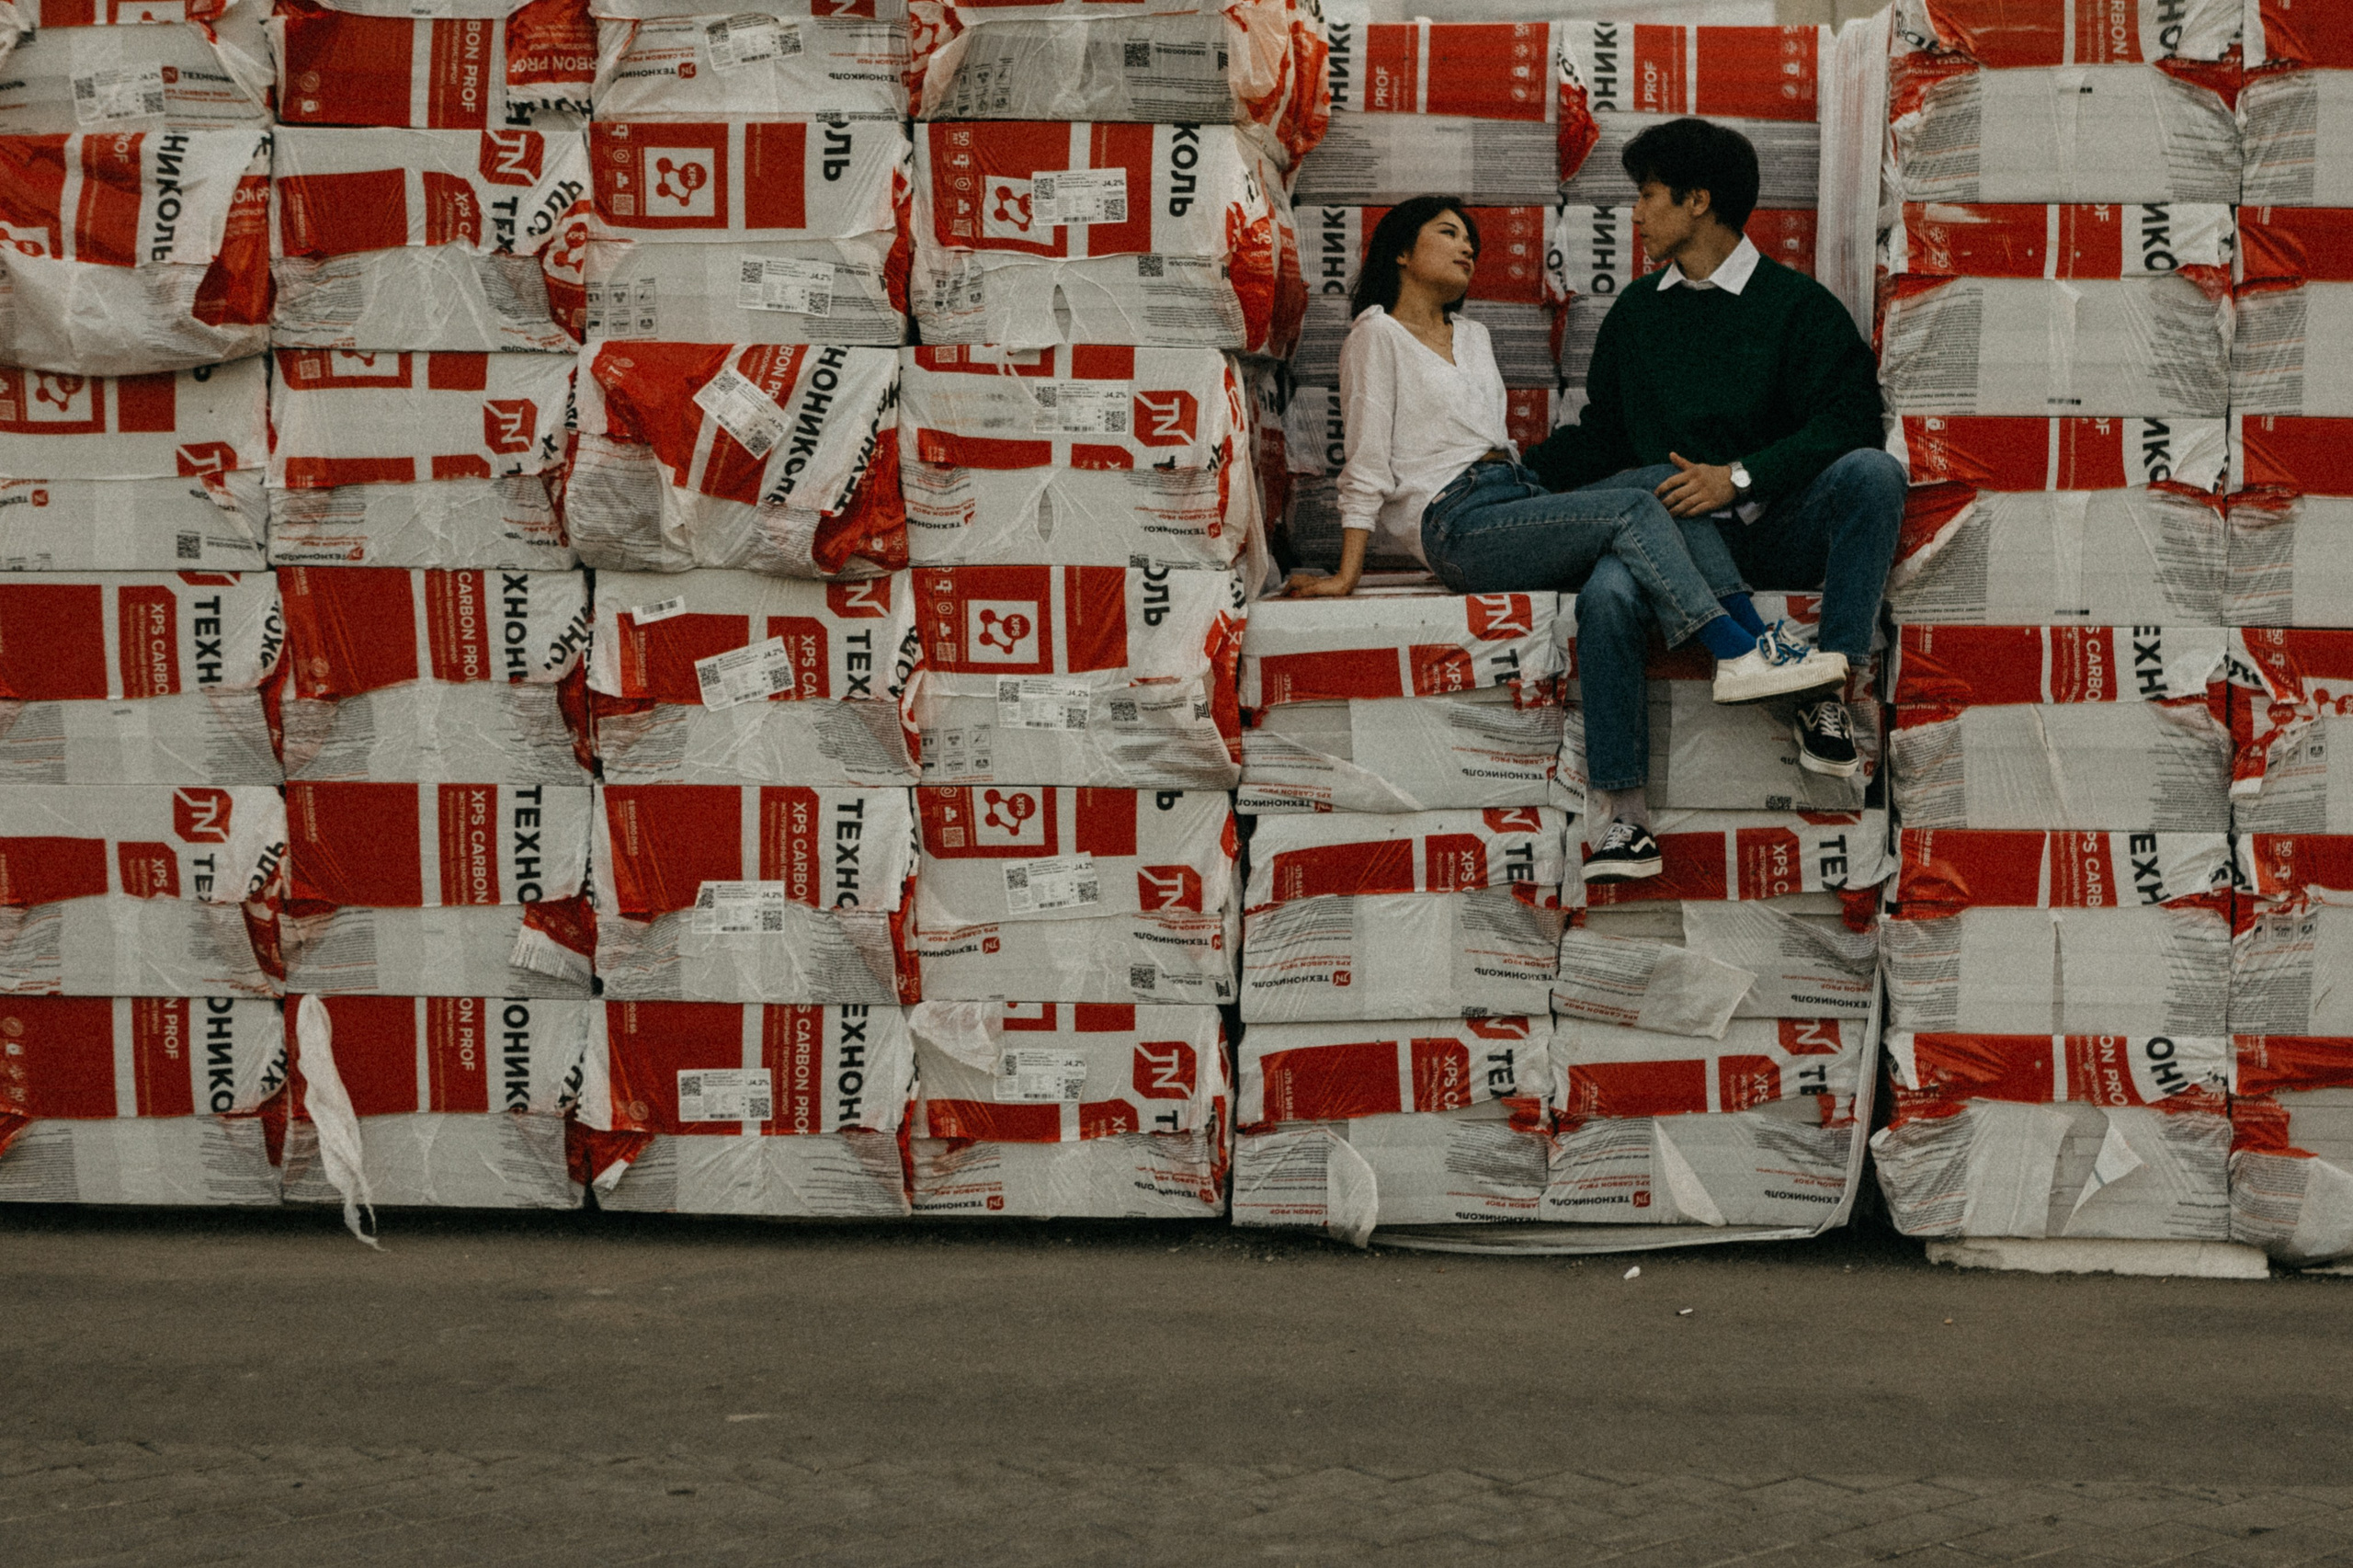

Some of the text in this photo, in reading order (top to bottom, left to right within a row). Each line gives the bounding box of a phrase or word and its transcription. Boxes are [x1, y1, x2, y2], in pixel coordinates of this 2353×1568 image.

[509, 56, 548, 74] PROF
[461, 65, 478, 113] PROF
[1376, 66, 1390, 107] PROF
[1645, 62, 1658, 104] PROF
[688, 165, 697, 187] XPS
[1169, 125, 1199, 217] КОЛЬ
[153, 135, 189, 262] НИКОЛЬ
[1134, 392, 1197, 447] TN
[151, 603, 165, 635] XPS
[458, 572, 475, 641] CARBON
[1011, 617, 1020, 637] XPS
[801, 634, 815, 669] XPS
[1445, 661, 1462, 693] XPS
[1461, 768, 1544, 780] ТЕХНОНИКОЛЬ
[1016, 796, 1025, 817] XPS
[1280, 790, 1314, 798] CARBON
[174, 788, 230, 843] TN
[793, 801, 807, 834] XPS
[472, 790, 488, 903] XPS CARBON
[1772, 844, 1789, 876] XPS
[2280, 840, 2292, 857] 50
[152, 858, 168, 887] XPS
[1460, 850, 1475, 883] XPS
[1133, 932, 1209, 947] ТЕХНОНИКОЛЬ
[1301, 960, 1333, 969] CARBON
[1473, 968, 1554, 982] ТЕХНОНИКОЛЬ
[1252, 975, 1330, 988] ТЕХНОНИКОЛЬ
[164, 1014, 178, 1059] PROF
[460, 1027, 475, 1071] PROF
[503, 997, 530, 1111] ОНИК
[796, 1018, 810, 1091] CARBON
[1133, 1042, 1195, 1100] TN
[1444, 1055, 1458, 1087] XPS
[1549, 1196, 1631, 1207] ТЕХНОНИКОЛЬ
